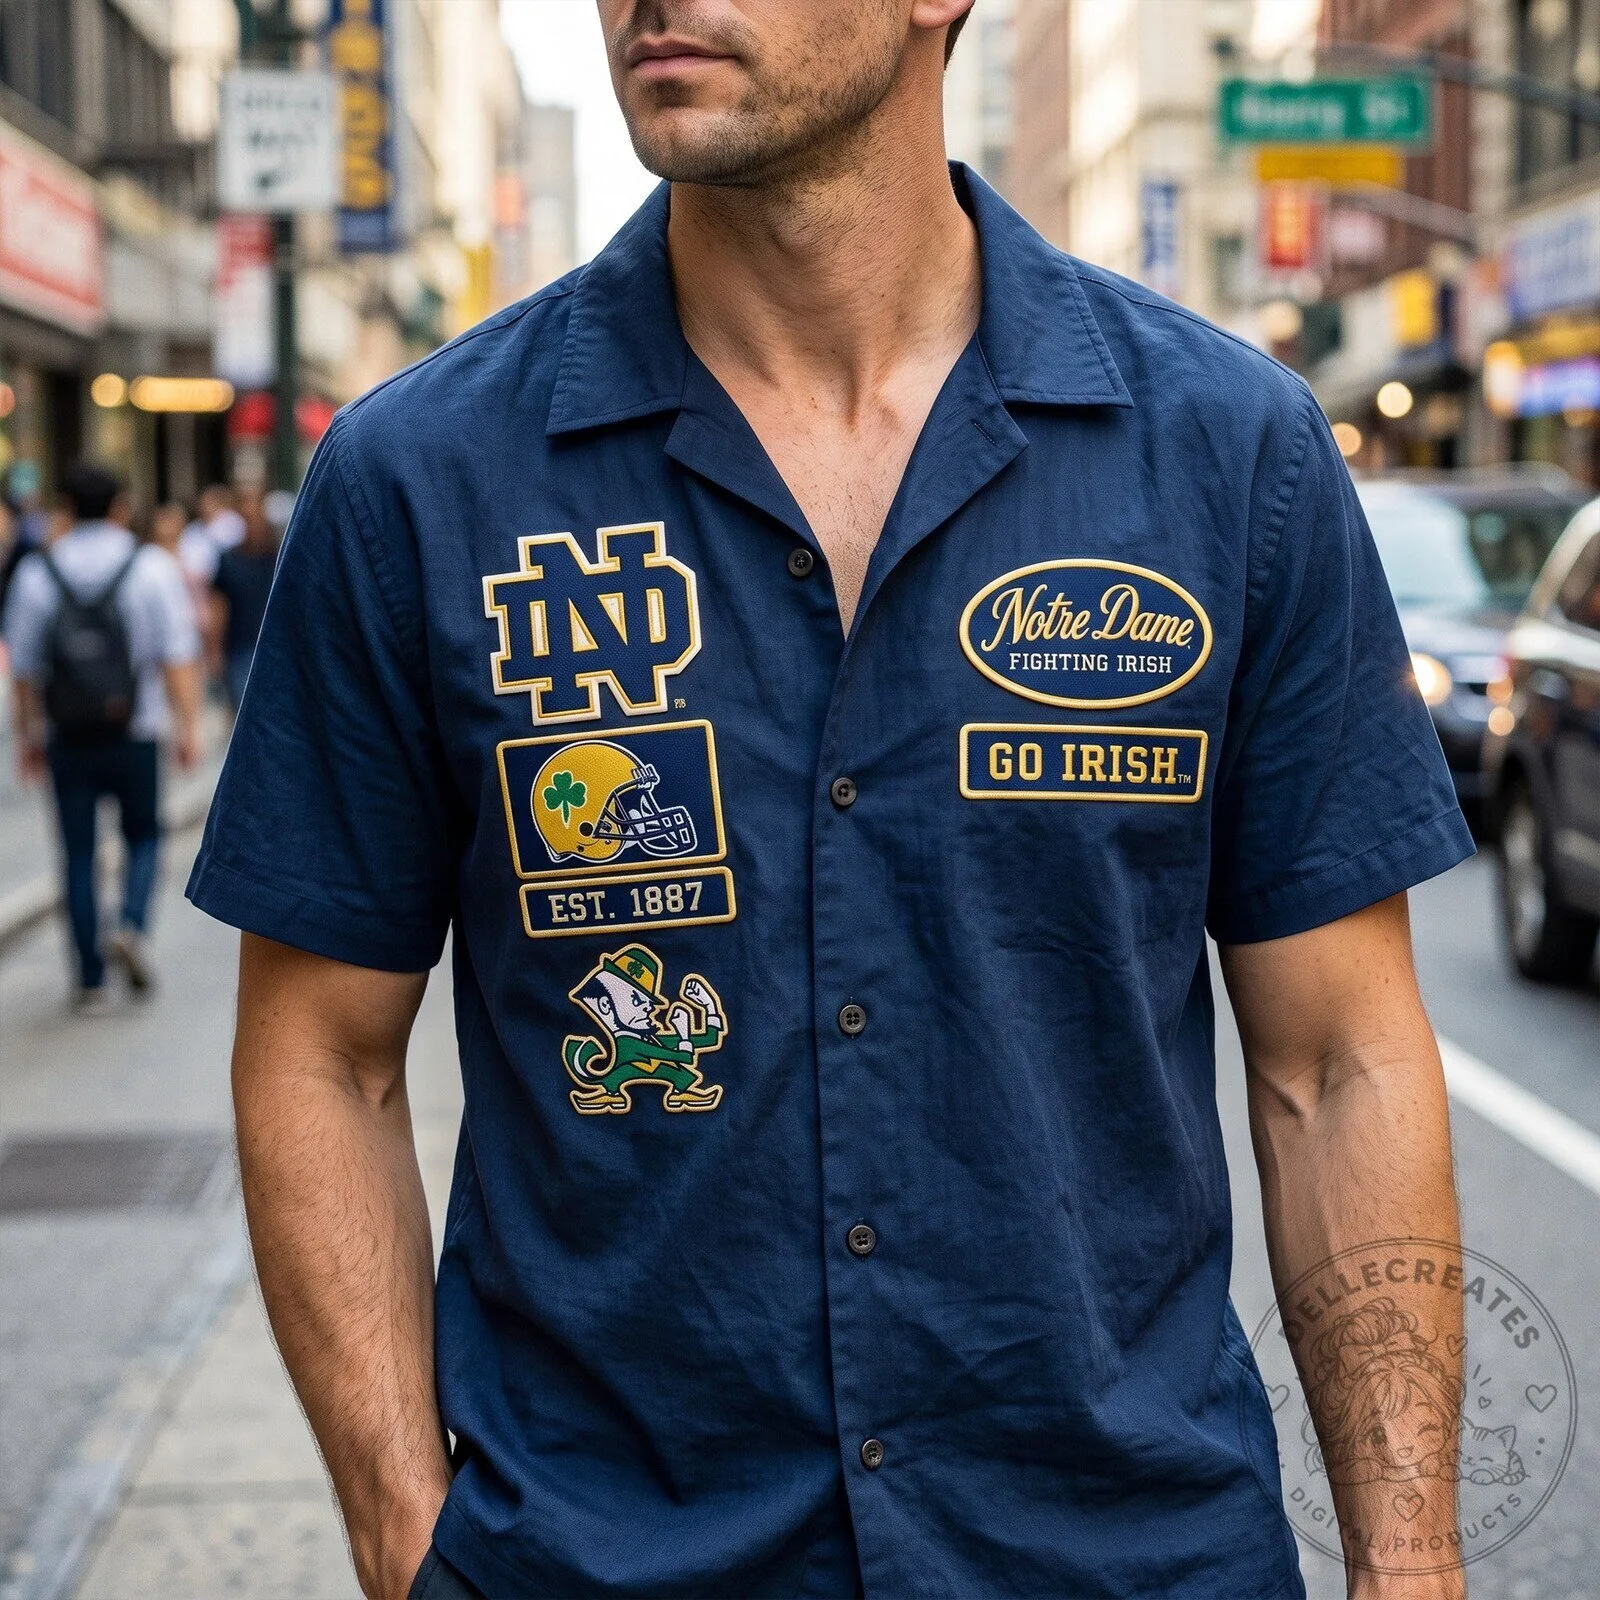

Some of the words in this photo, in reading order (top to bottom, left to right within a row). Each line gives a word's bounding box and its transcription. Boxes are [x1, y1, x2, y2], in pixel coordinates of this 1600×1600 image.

[981, 583, 1091, 652] Notre
[1091, 583, 1195, 647] Dame
[1009, 652, 1108, 672] FIGHTING
[1117, 654, 1172, 674] IRISH
[988, 742, 1043, 781] GO
[1061, 743, 1179, 785] IRISH
[547, 890, 616, 924] EST.
[630, 881, 703, 918] 1887
